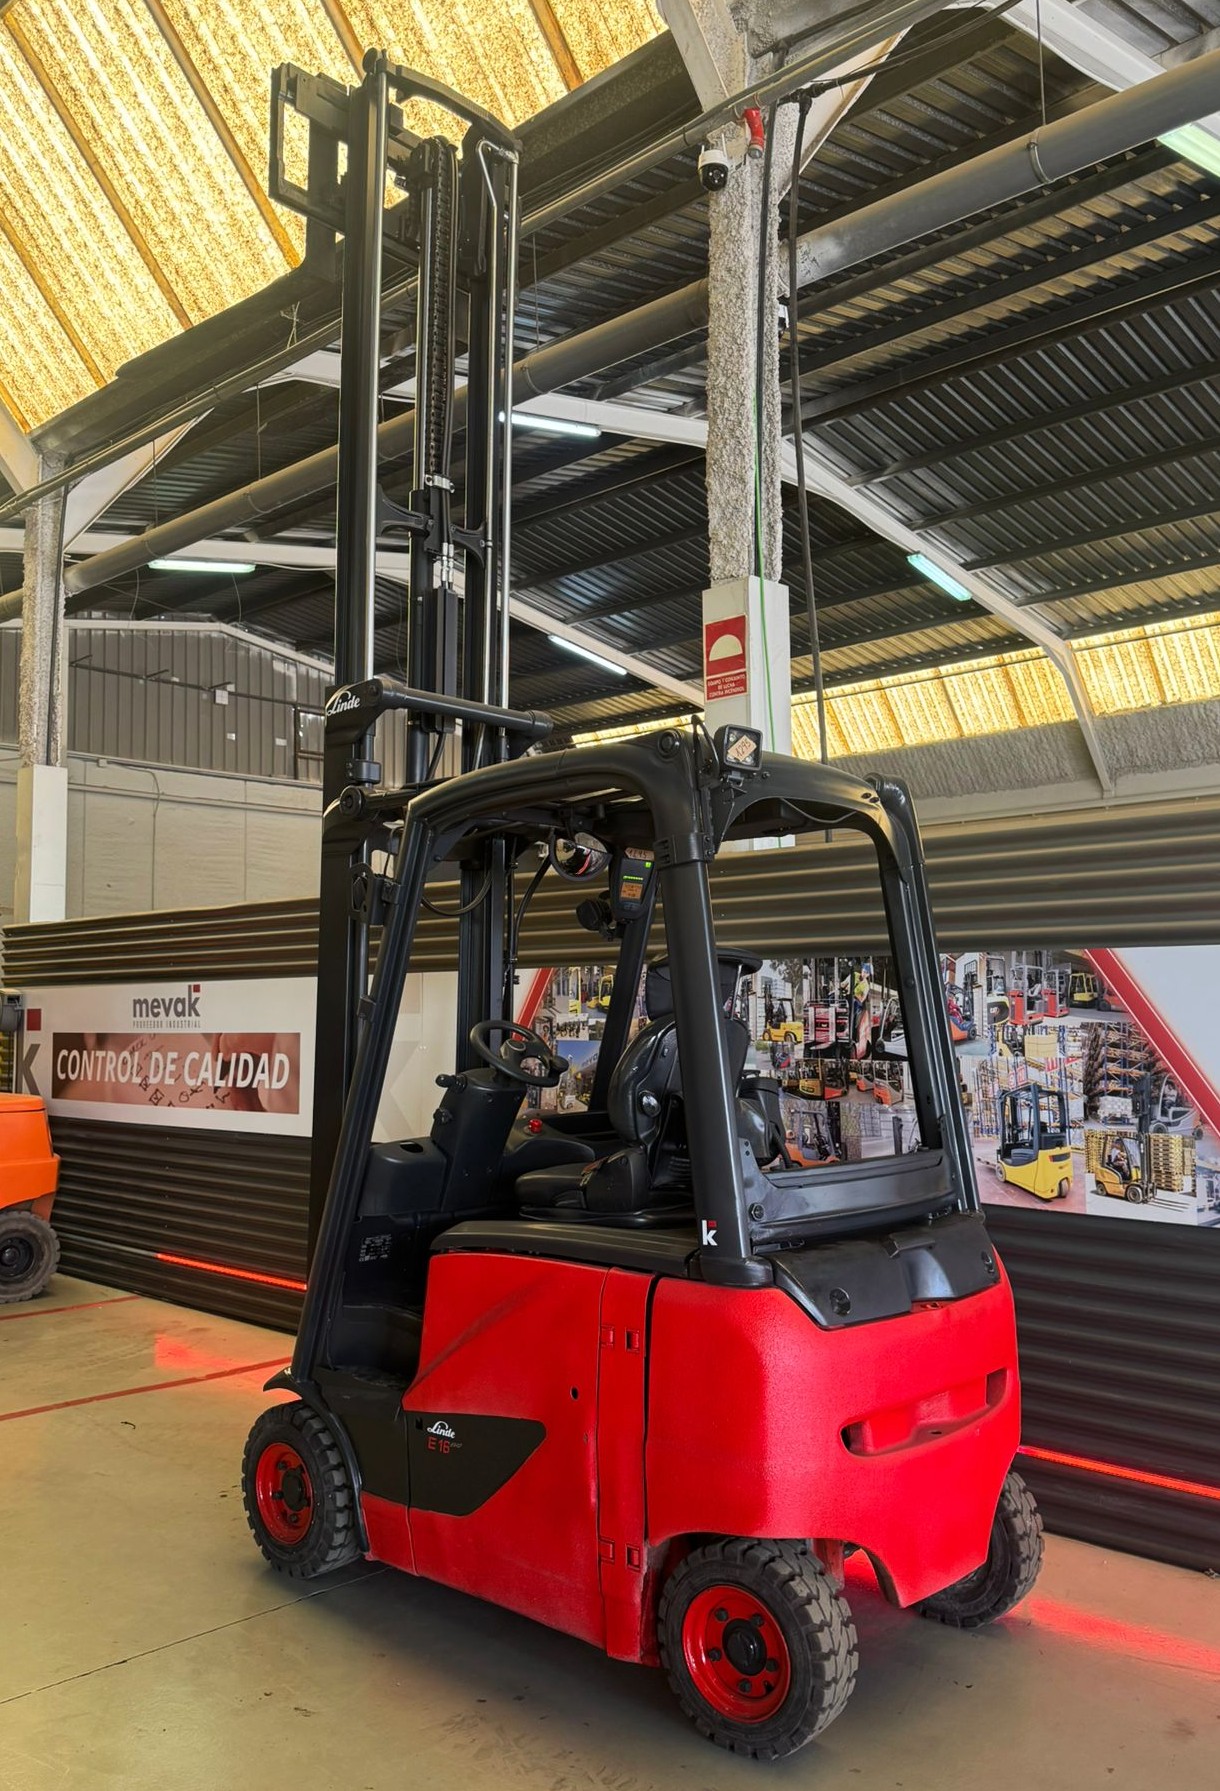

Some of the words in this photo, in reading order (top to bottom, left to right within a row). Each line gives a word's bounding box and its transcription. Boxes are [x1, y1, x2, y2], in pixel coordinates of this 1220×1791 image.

[327, 690, 360, 716] Linde
[132, 984, 201, 1018] mevak
[57, 1049, 142, 1085] CONTROL
[150, 1051, 179, 1085] DE
[183, 1051, 290, 1090] CALIDAD
[702, 1219, 718, 1246] k
[427, 1420, 456, 1438] Linde
[428, 1436, 437, 1450] E
[438, 1440, 450, 1454] 16
